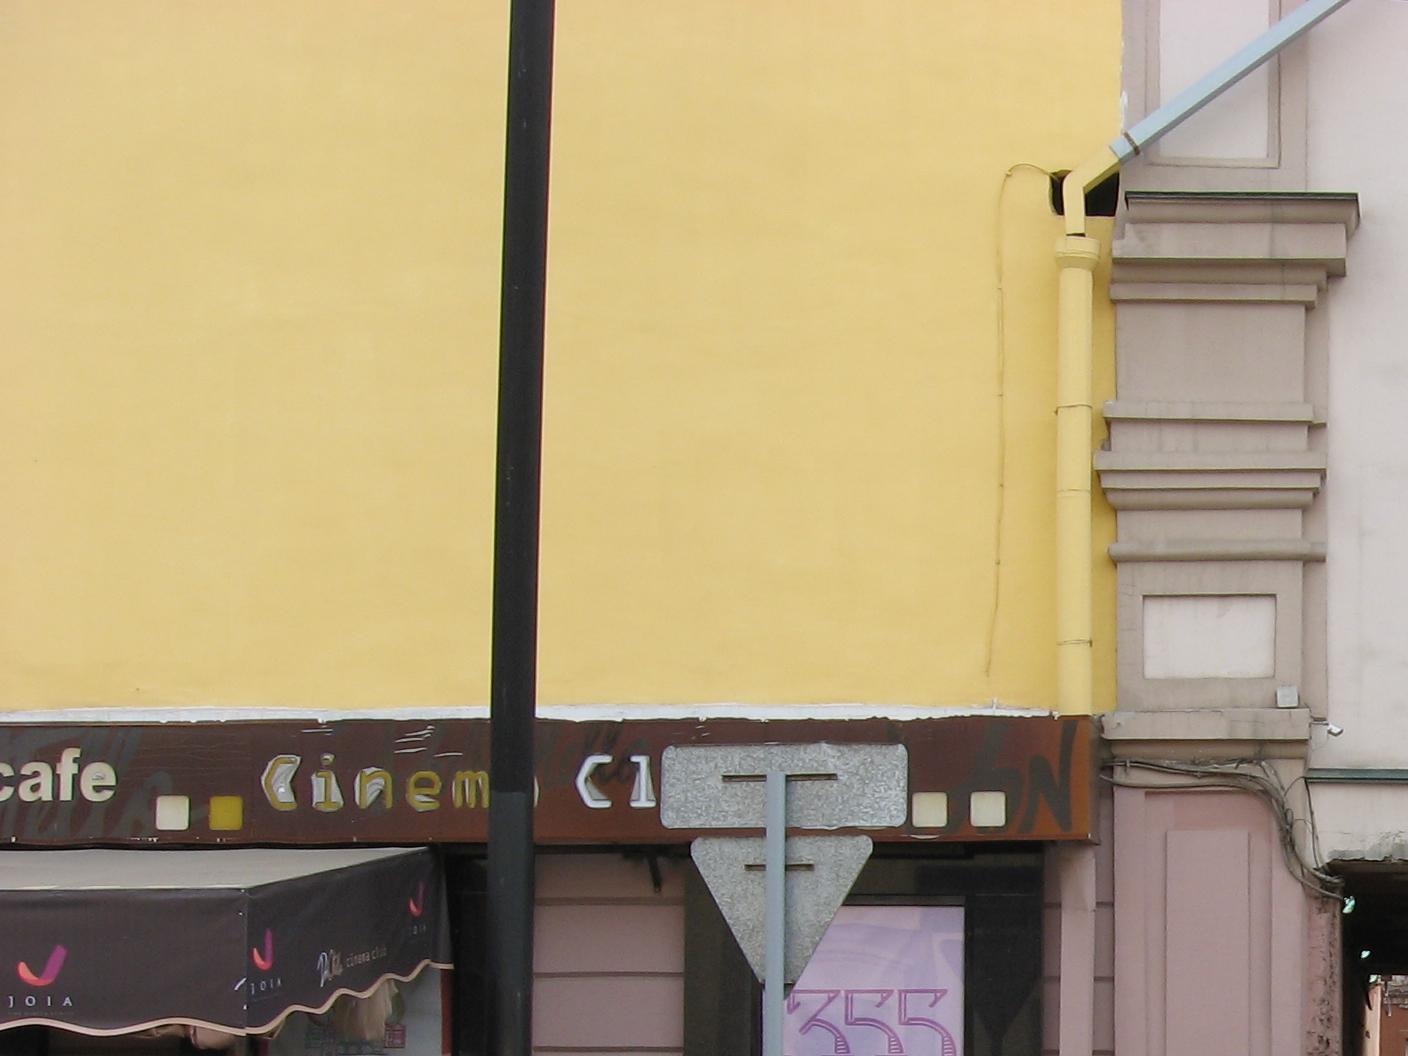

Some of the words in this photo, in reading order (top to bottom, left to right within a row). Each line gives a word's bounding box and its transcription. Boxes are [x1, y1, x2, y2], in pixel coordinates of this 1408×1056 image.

[260, 753, 539, 812] Cinem
[249, 977, 283, 995] JOIA
[8, 995, 74, 1008] JOIA
